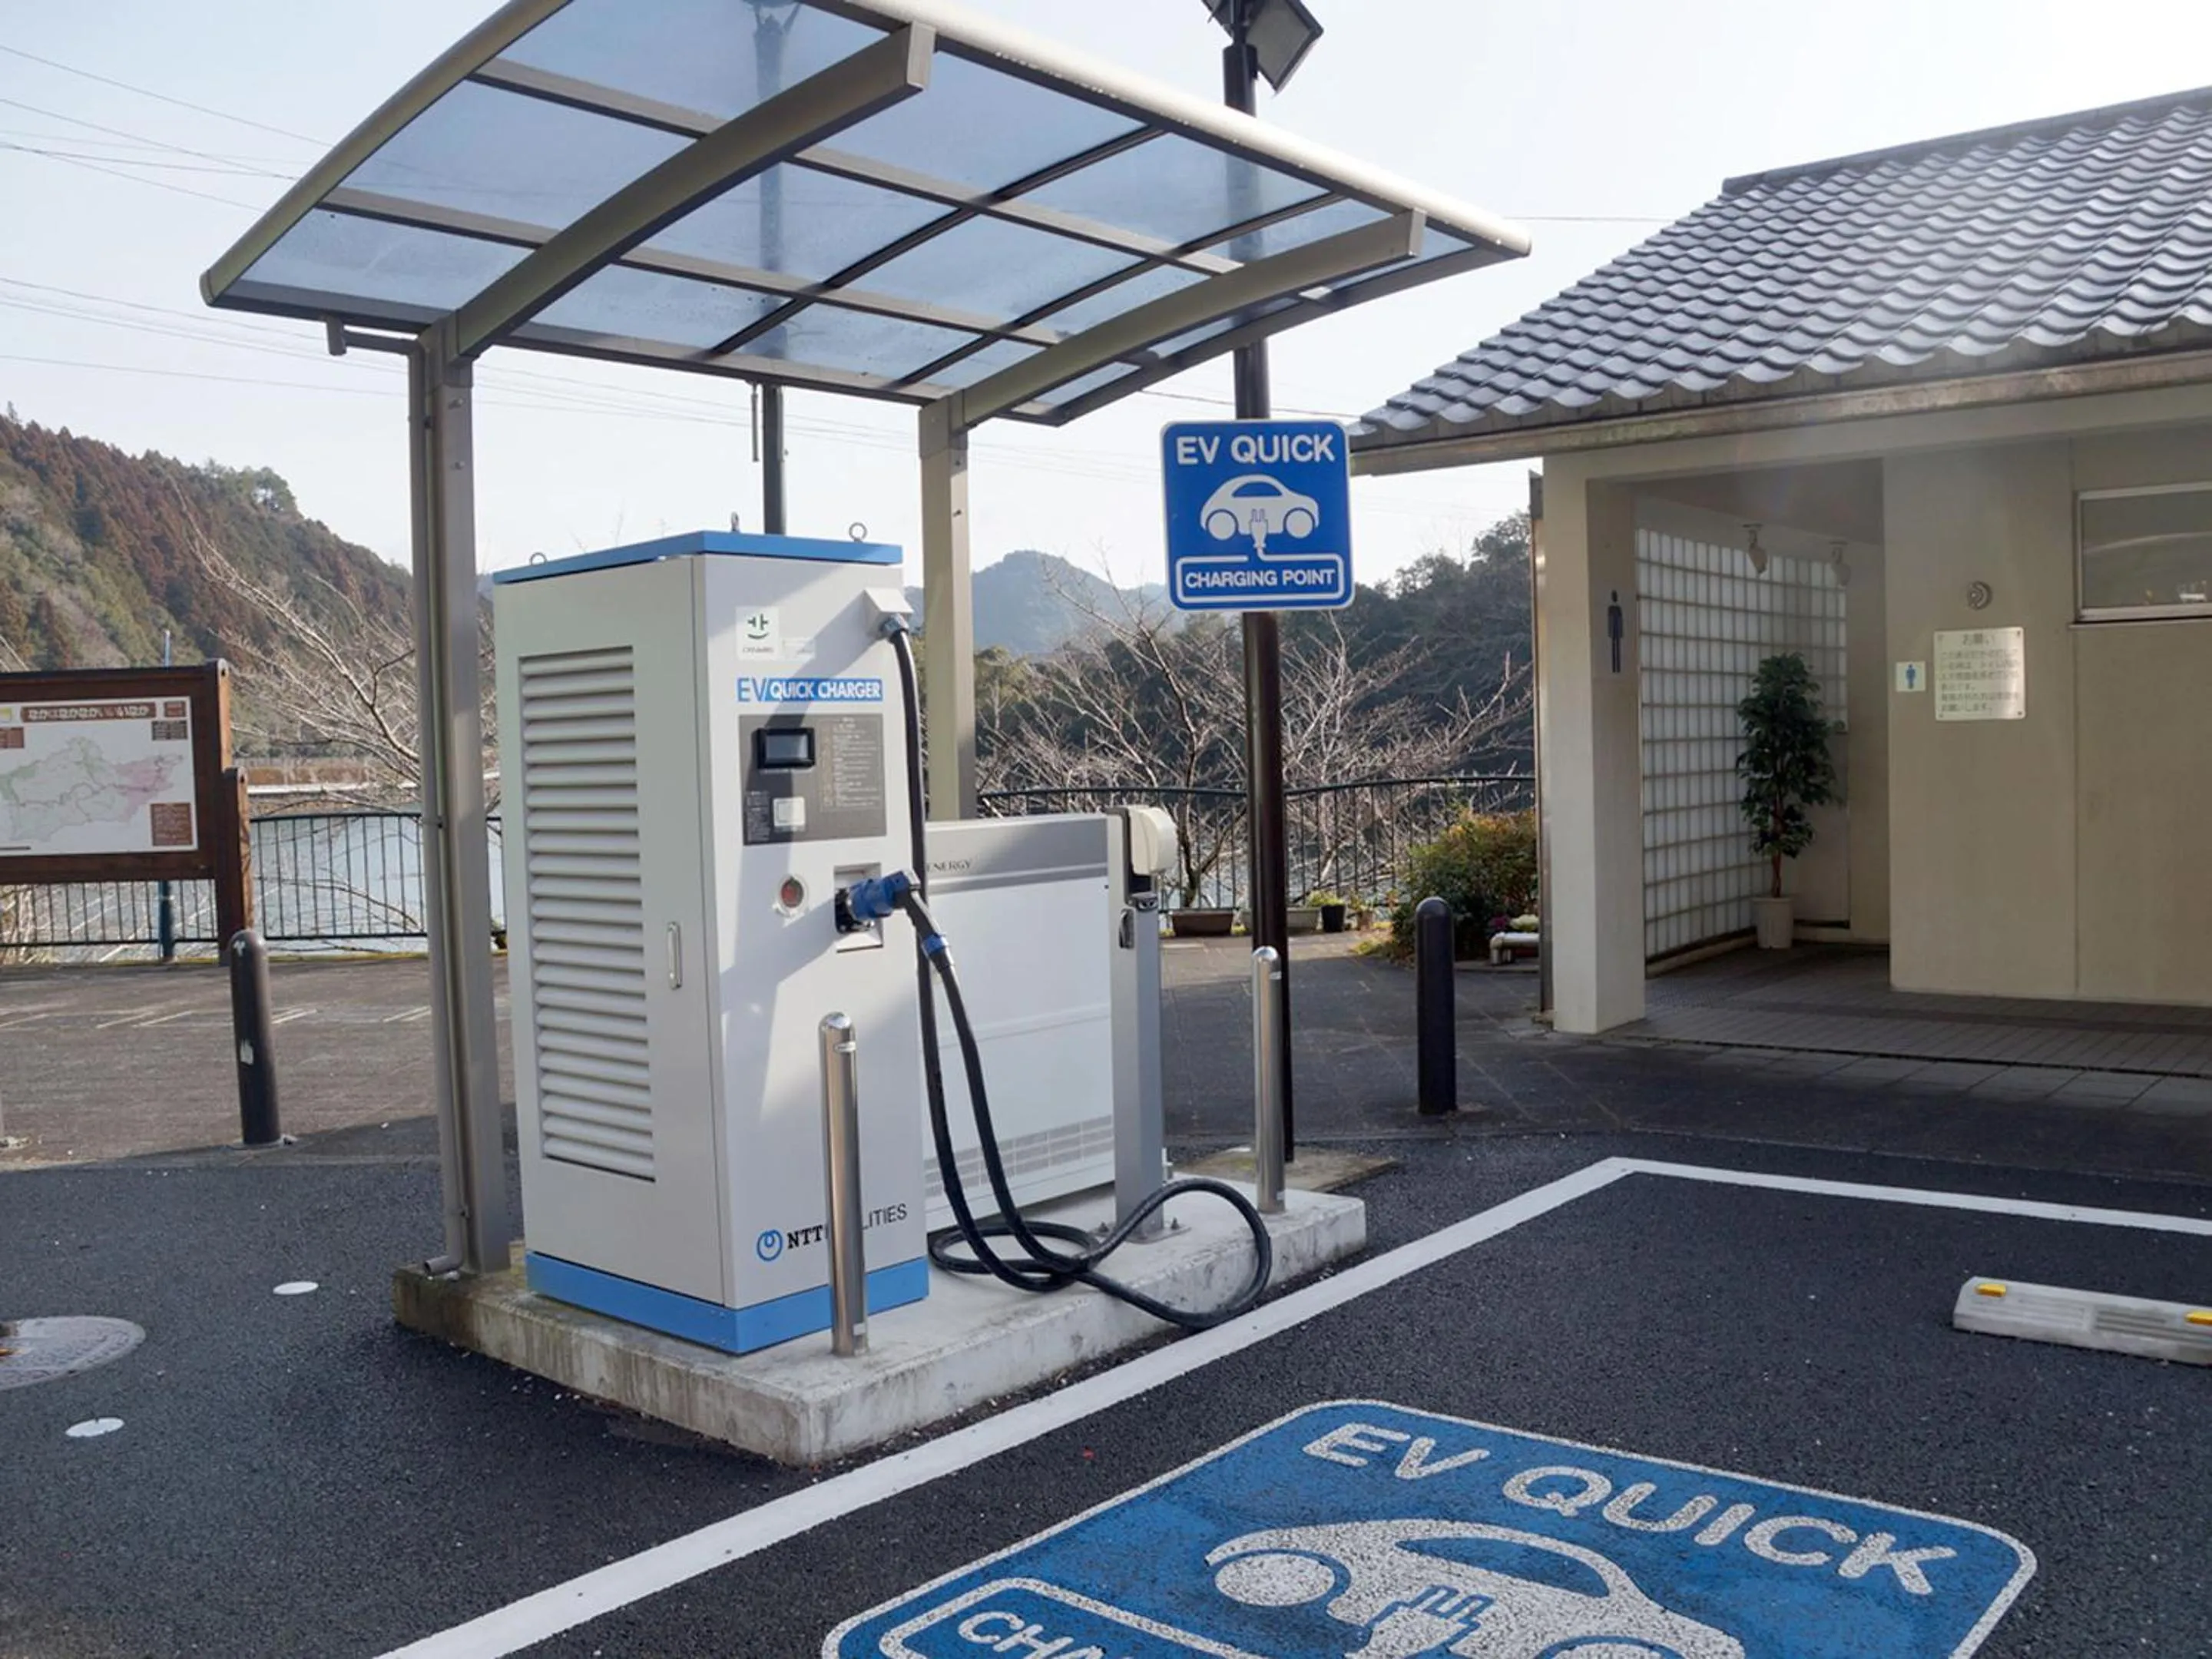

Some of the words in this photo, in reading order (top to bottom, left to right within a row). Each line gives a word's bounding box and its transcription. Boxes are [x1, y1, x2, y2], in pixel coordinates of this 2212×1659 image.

[1177, 435, 1220, 464] EV
[1231, 434, 1336, 464] QUICK
[1185, 571, 1277, 588] CHARGING
[1283, 569, 1336, 586] POINT
[818, 680, 882, 700] CHARGER
[786, 1225, 823, 1249] NTT
[1303, 1422, 1490, 1479] EV
[1503, 1465, 1957, 1595] QUICK
